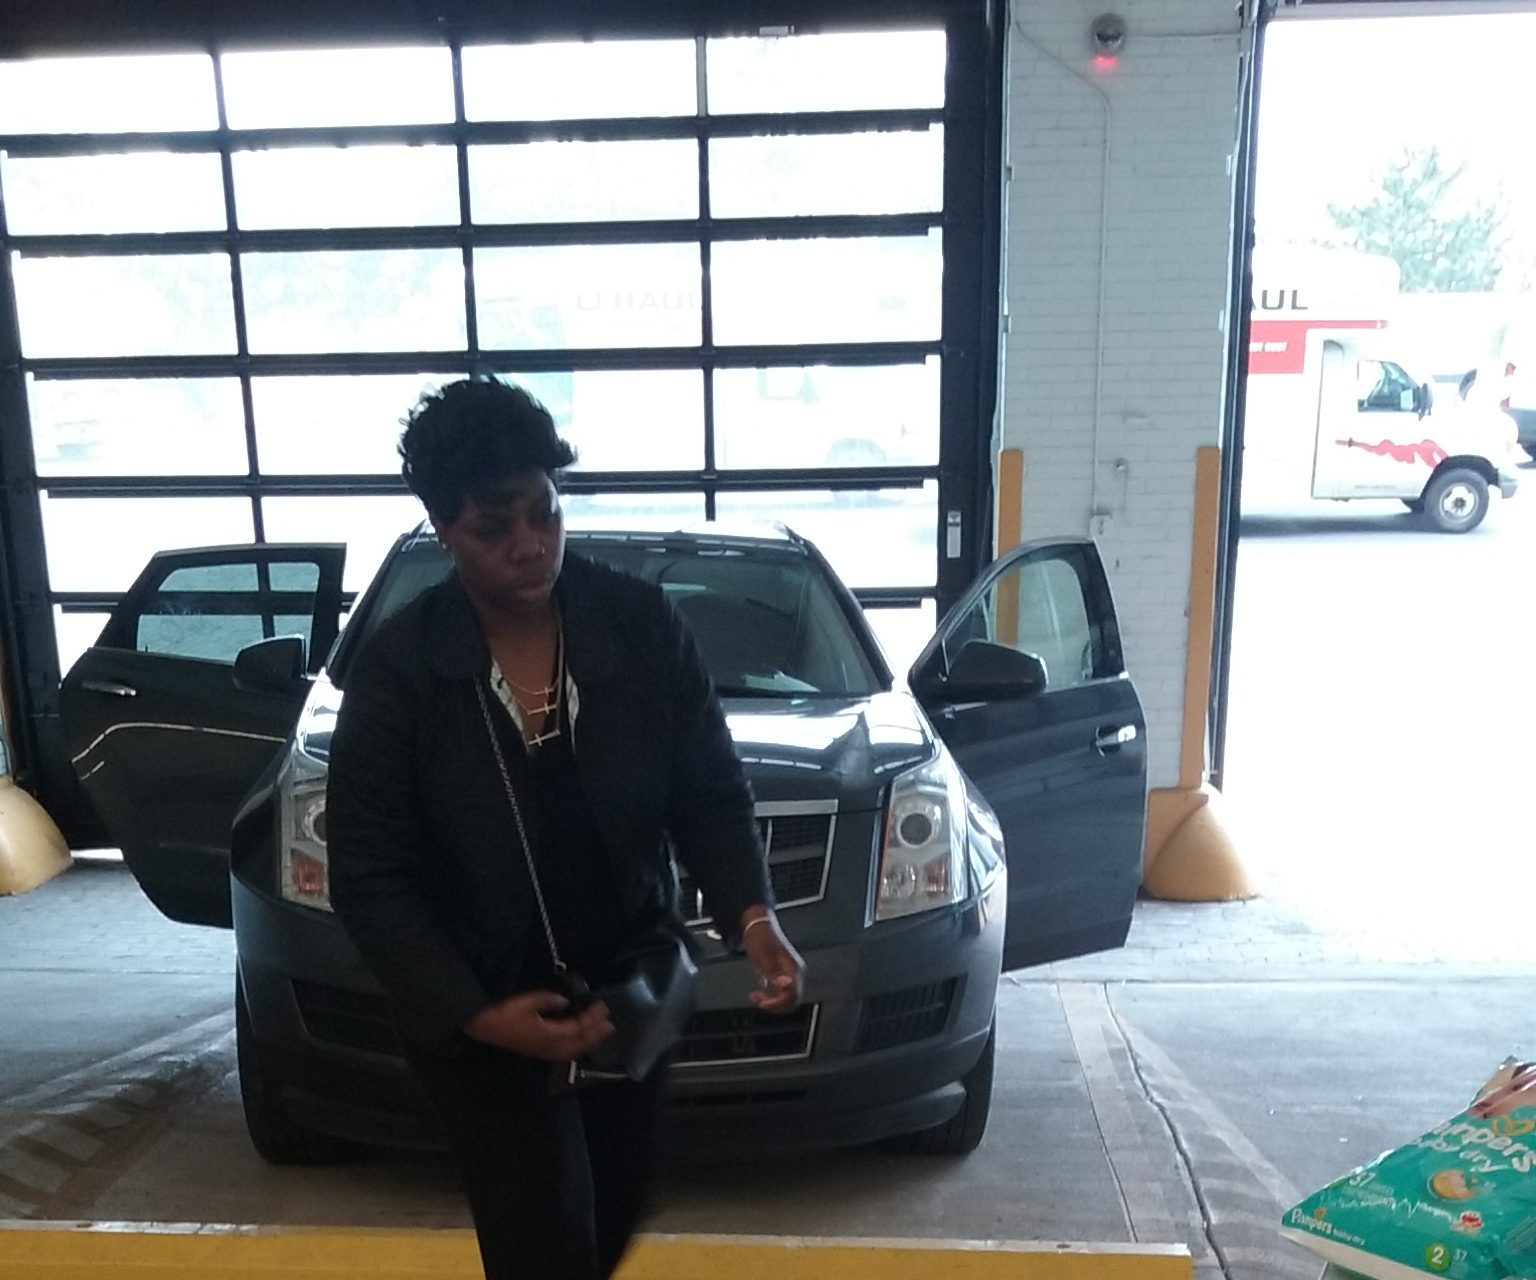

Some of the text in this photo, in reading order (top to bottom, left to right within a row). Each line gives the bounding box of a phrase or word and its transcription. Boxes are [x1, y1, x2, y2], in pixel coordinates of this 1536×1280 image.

[1250, 289, 1308, 310] UL
[1291, 1207, 1333, 1235] Pampers
[1431, 1246, 1444, 1265] 2
